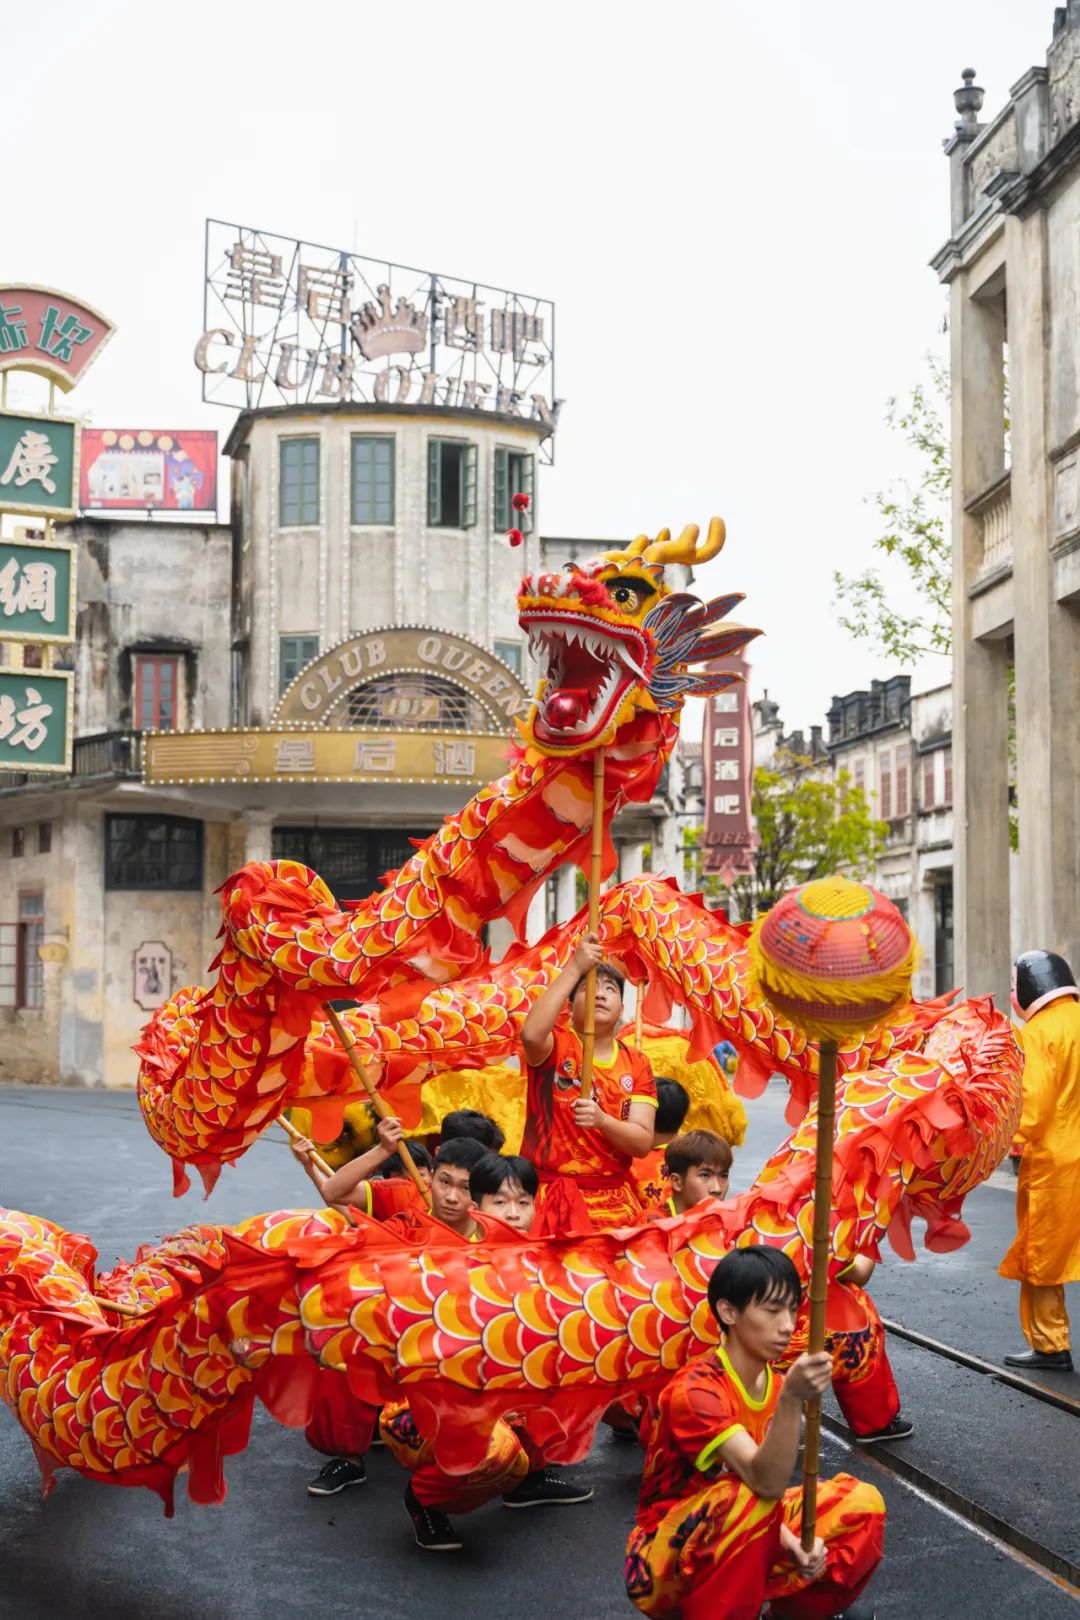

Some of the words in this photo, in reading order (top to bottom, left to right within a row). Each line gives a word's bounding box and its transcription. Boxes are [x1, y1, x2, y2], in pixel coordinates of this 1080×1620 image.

[223, 241, 354, 325] 皇后
[432, 288, 546, 367] 酒吧
[194, 328, 354, 398] CLUB
[373, 365, 567, 426] QUEEN
[300, 639, 387, 711] CLUB
[417, 636, 530, 717] QUEEN
[275, 738, 476, 776] 皇后酒
[713, 692, 741, 815] 皇后酒吧
